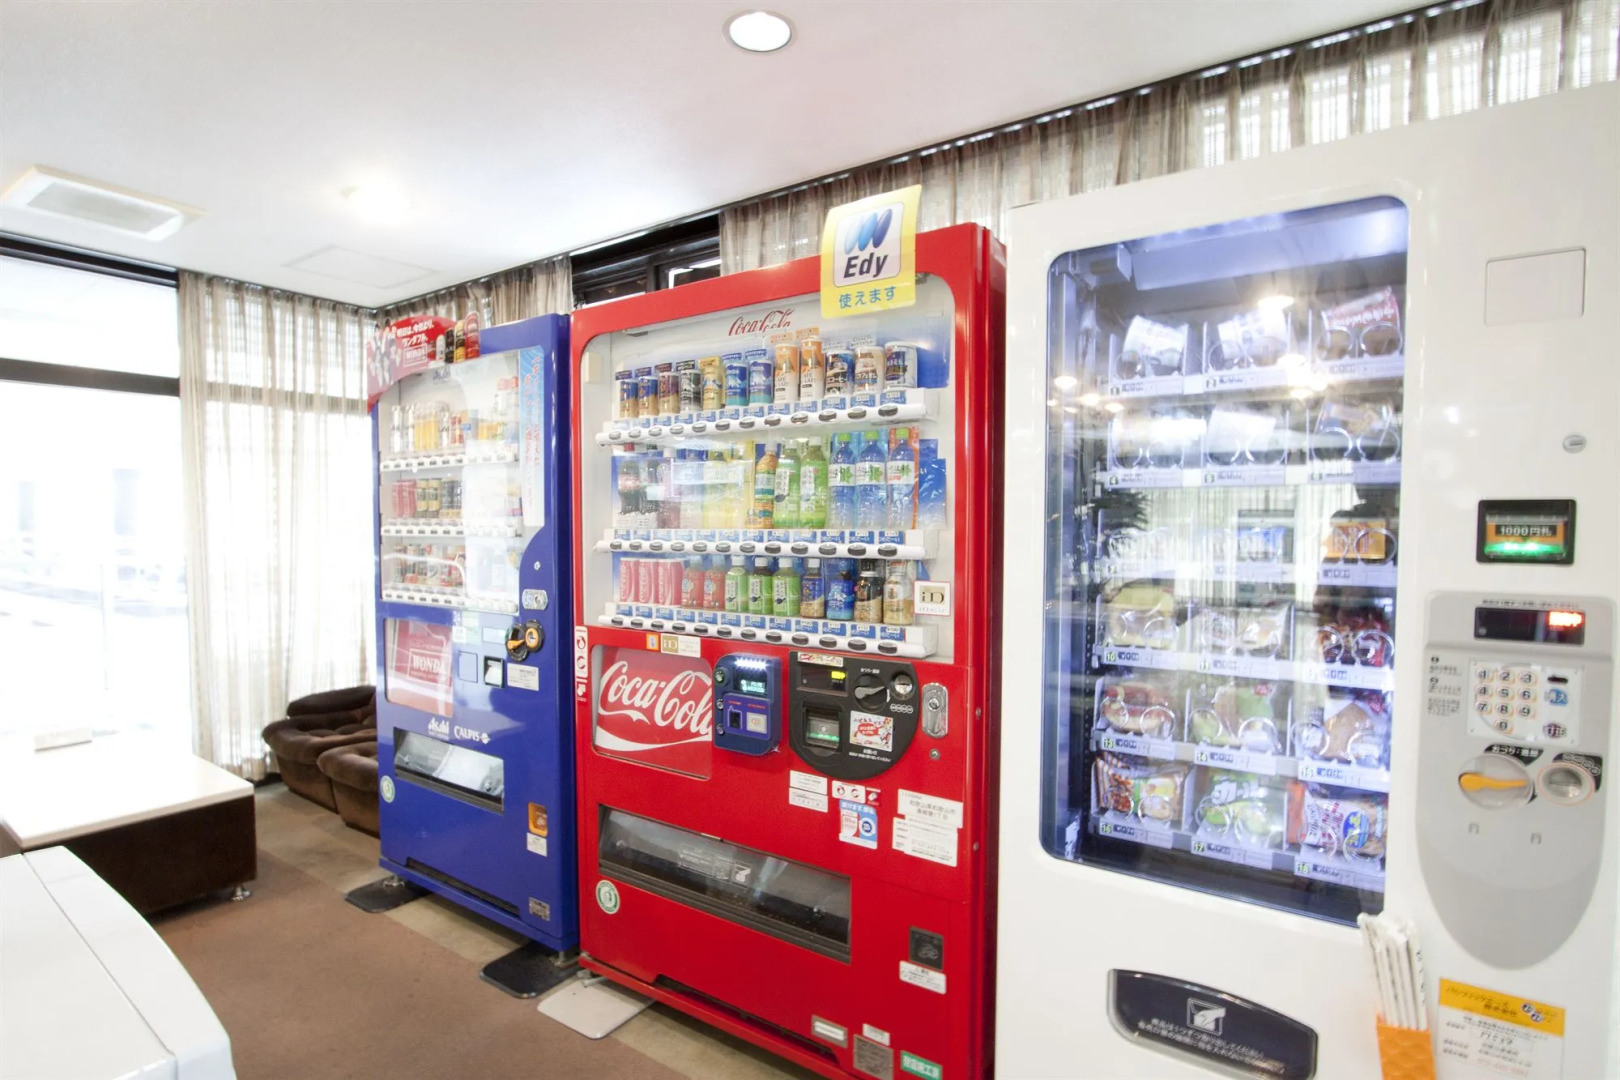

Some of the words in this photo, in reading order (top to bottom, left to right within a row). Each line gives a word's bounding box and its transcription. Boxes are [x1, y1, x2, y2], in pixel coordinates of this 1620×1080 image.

[843, 251, 889, 279] Edy
[838, 285, 897, 309] 使えます
[727, 308, 796, 336] Coca-Cola
[1500, 526, 1552, 537] 1000円札
[1501, 671, 1510, 681] 2
[1521, 673, 1532, 684] 3
[1479, 686, 1488, 696] 4
[1500, 688, 1509, 698] 5
[1521, 690, 1531, 700] 6
[1478, 702, 1488, 712] 7
[1500, 704, 1509, 714] 8
[1520, 706, 1530, 716] 9
[428, 717, 449, 735] Asahi
[453, 724, 480, 743] CALPIS
